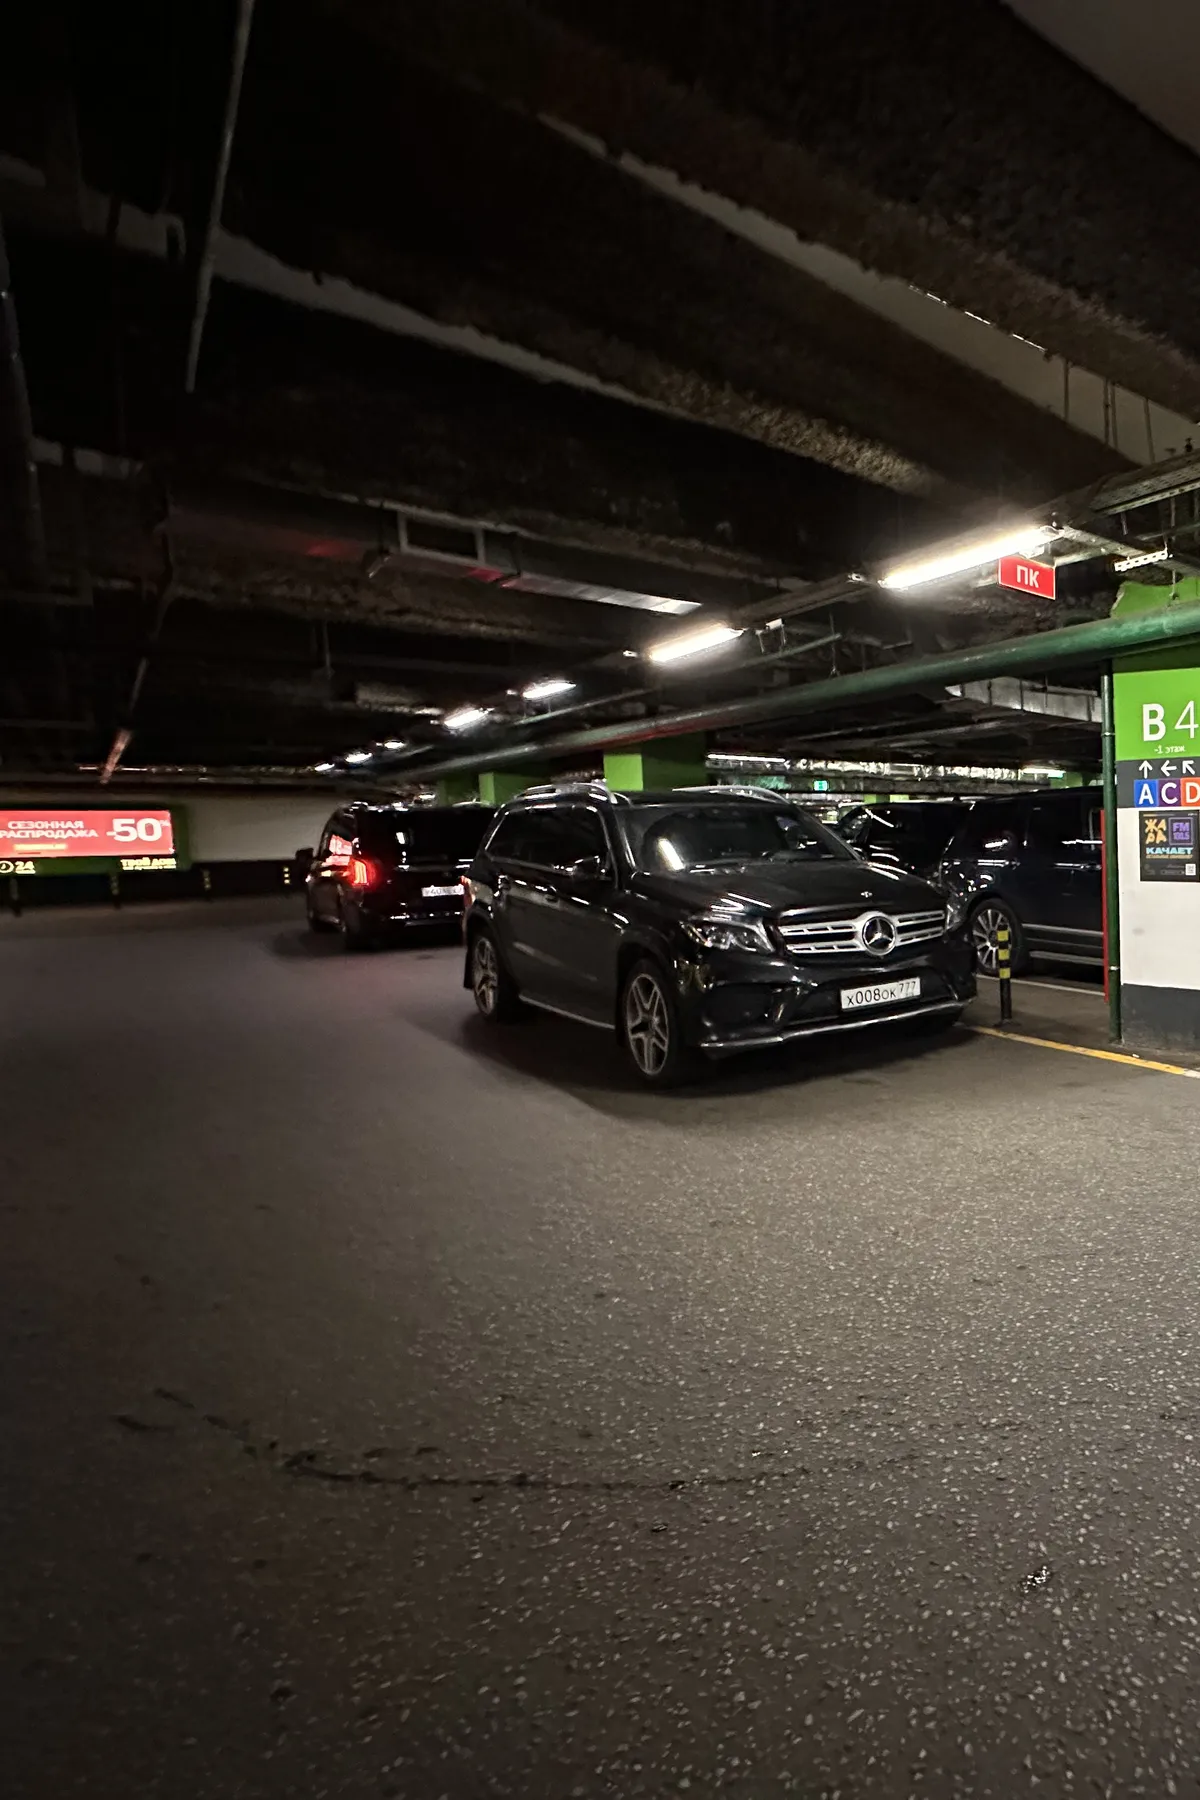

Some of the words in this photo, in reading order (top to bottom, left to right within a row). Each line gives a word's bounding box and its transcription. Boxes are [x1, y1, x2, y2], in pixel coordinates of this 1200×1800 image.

[1016, 564, 1040, 588] ПК
[1165, 745, 1186, 754] этаж
[1138, 783, 1154, 805] A
[1161, 782, 1178, 804] C
[7, 820, 85, 830] СЕЗОННАЯ
[1173, 822, 1190, 832] FM
[0, 829, 99, 839] РАСПРОДАЖА
[1145, 846, 1194, 855] КАЧАЕТ
